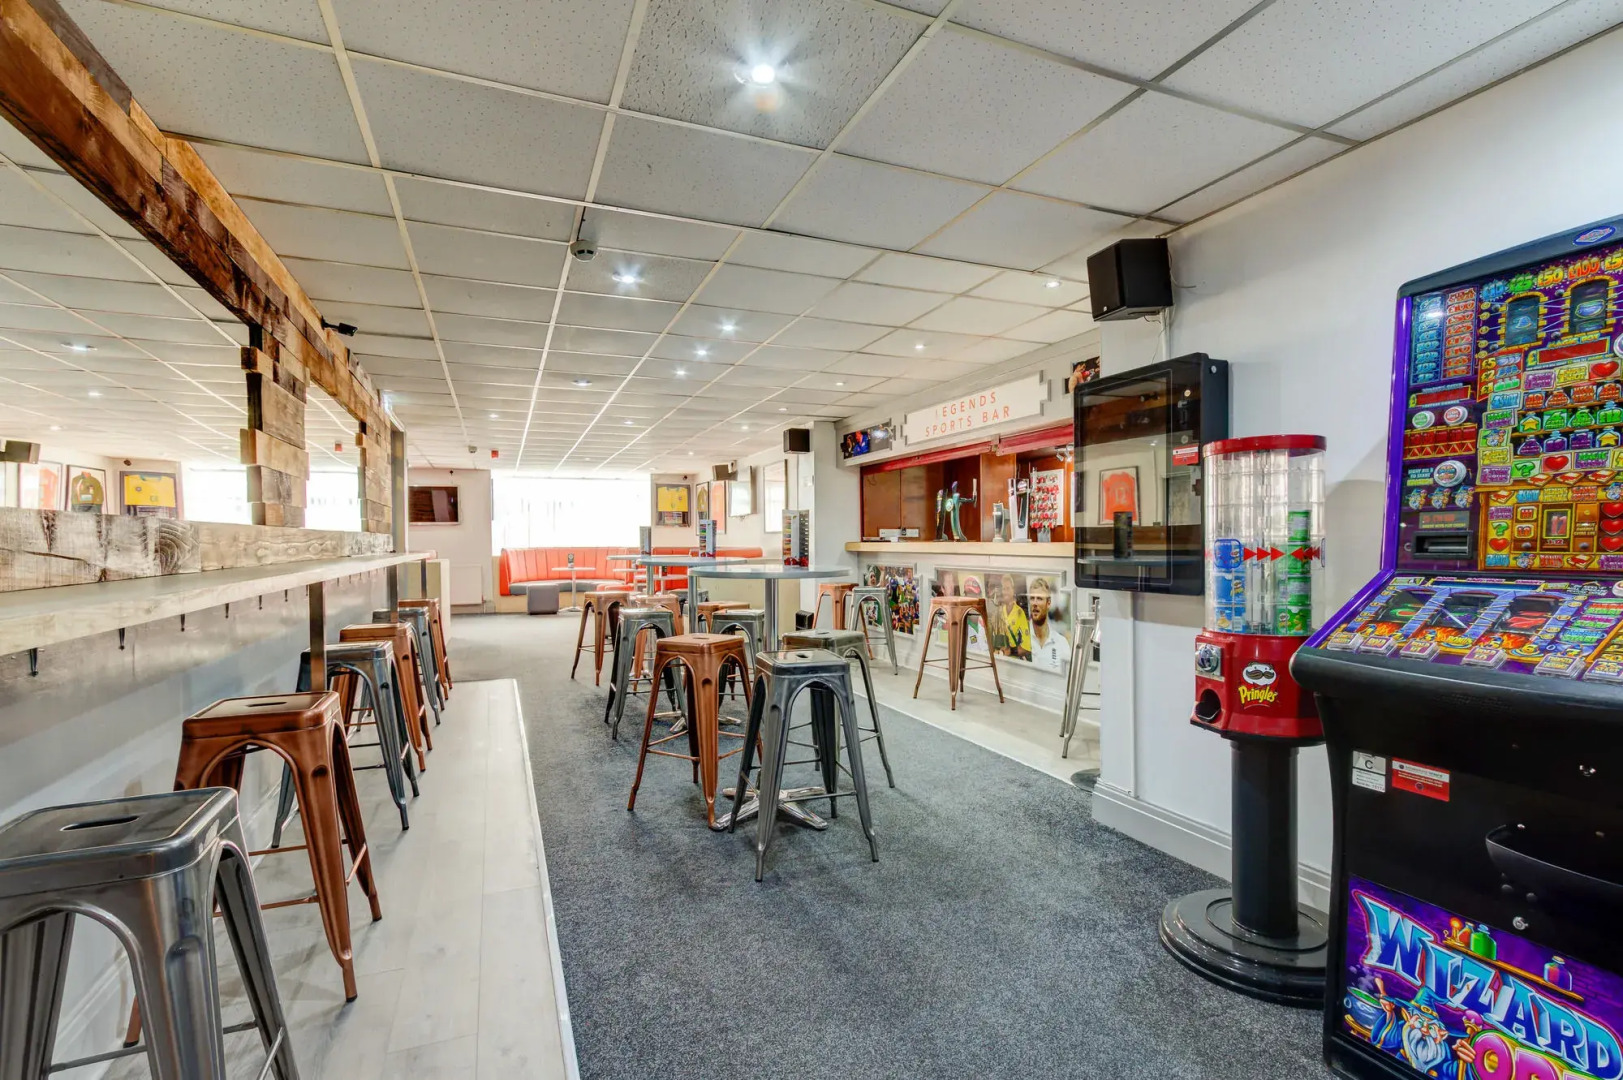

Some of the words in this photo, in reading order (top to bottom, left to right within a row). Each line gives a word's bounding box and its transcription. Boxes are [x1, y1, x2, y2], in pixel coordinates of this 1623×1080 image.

[1537, 269, 1563, 287] £50
[1568, 258, 1600, 279] £100
[926, 416, 972, 437] SPORTS
[983, 406, 1009, 423] BAR
[1238, 685, 1277, 704] Pringles
[1365, 760, 1373, 769] C
[1353, 890, 1622, 1079] WIZARD
